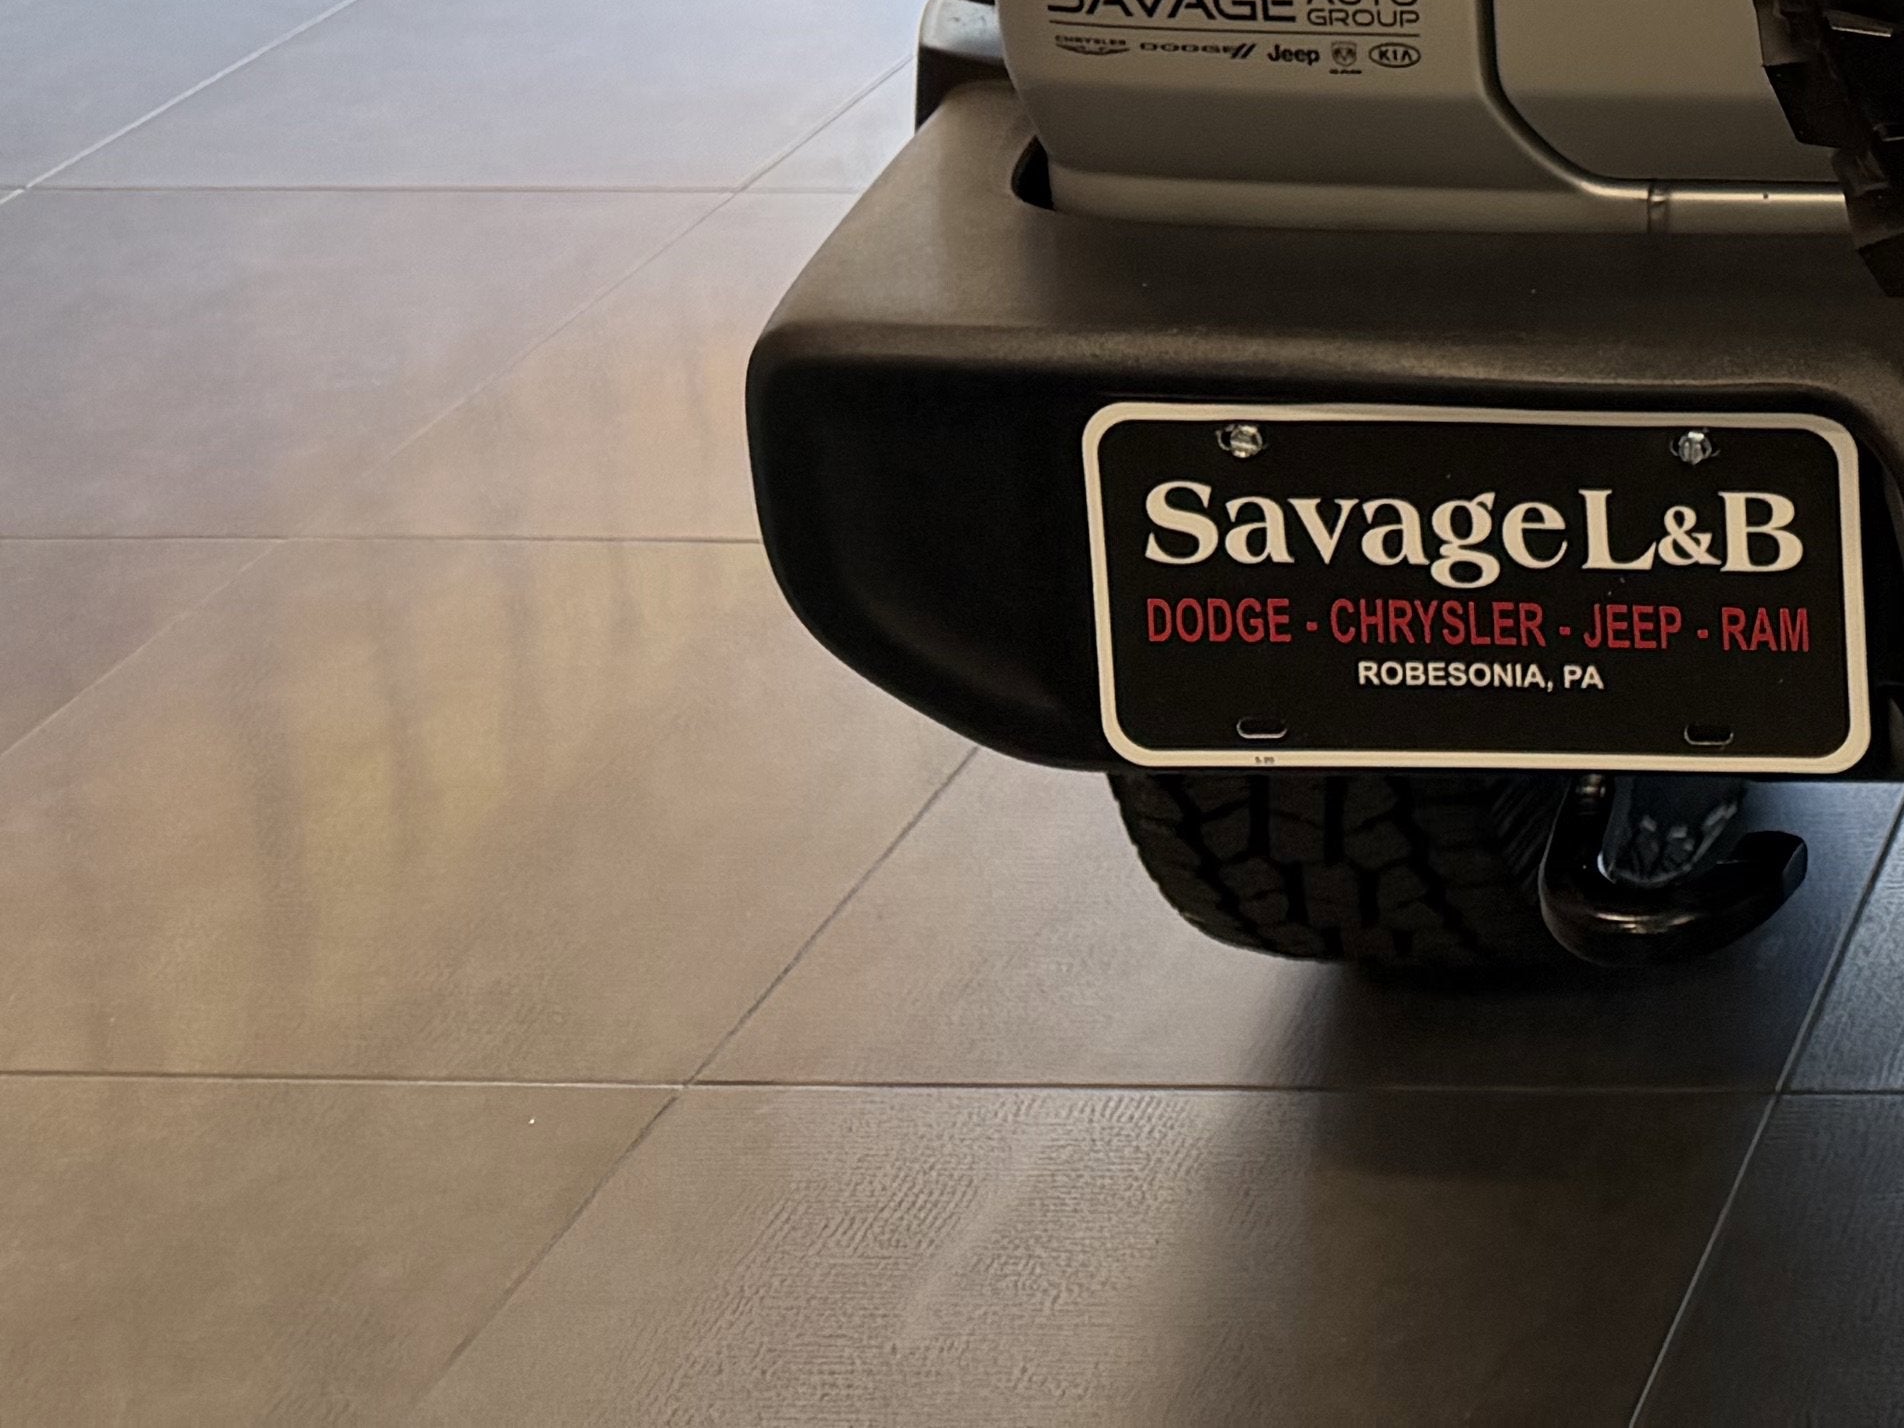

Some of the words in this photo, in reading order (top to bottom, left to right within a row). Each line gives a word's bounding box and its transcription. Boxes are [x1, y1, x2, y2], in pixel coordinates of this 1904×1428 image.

[1307, 7, 1420, 28] GROUP
[1267, 44, 1320, 66] Jeep
[1377, 48, 1412, 63] KIA
[1143, 480, 1568, 590] Savage
[1582, 489, 1804, 574] L&B
[1146, 597, 1292, 643] DODGE
[1329, 599, 1547, 648] CHRYSLER
[1583, 603, 1682, 651] JEEP
[1721, 607, 1810, 654] RAM
[1358, 660, 1554, 695] ROBESONIA,
[1564, 665, 1605, 691] PA
